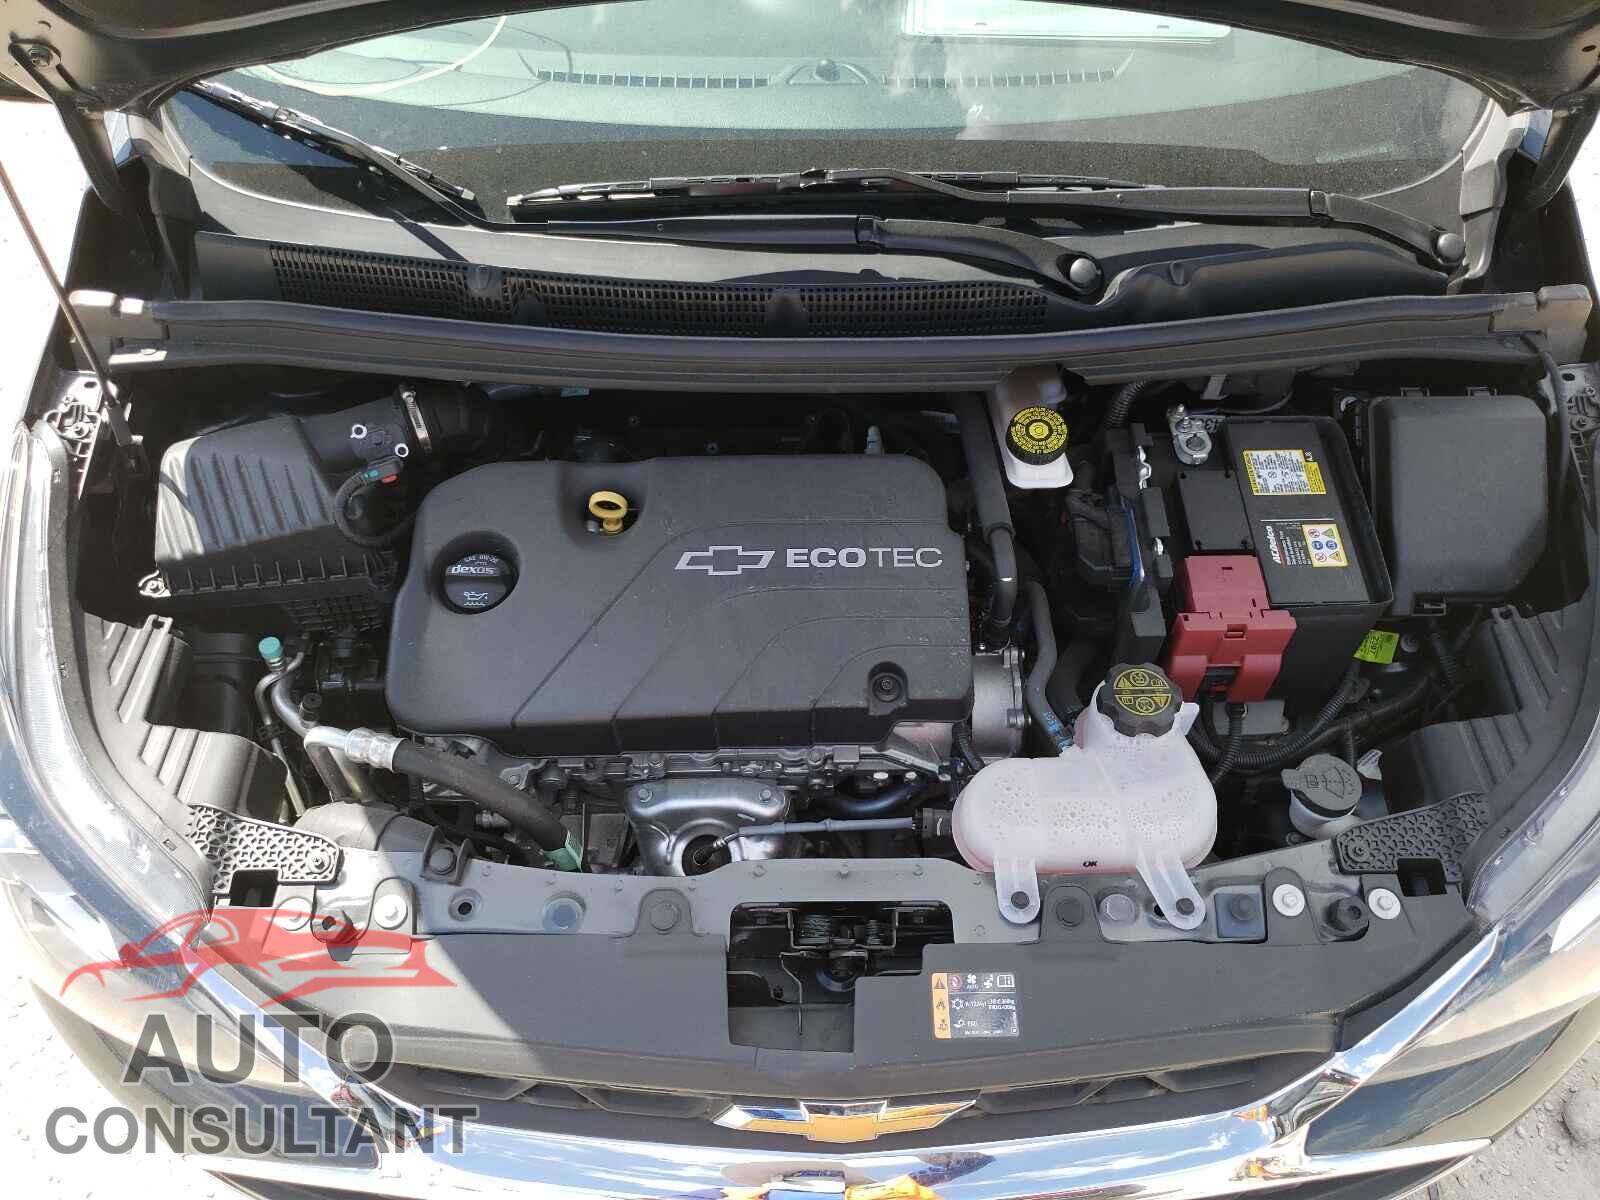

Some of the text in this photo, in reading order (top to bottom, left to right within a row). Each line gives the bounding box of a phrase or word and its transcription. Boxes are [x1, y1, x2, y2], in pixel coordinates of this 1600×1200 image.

[1265, 525, 1282, 565] ACDelco
[786, 547, 943, 568] ECOTEC
[451, 564, 497, 575] dexos
